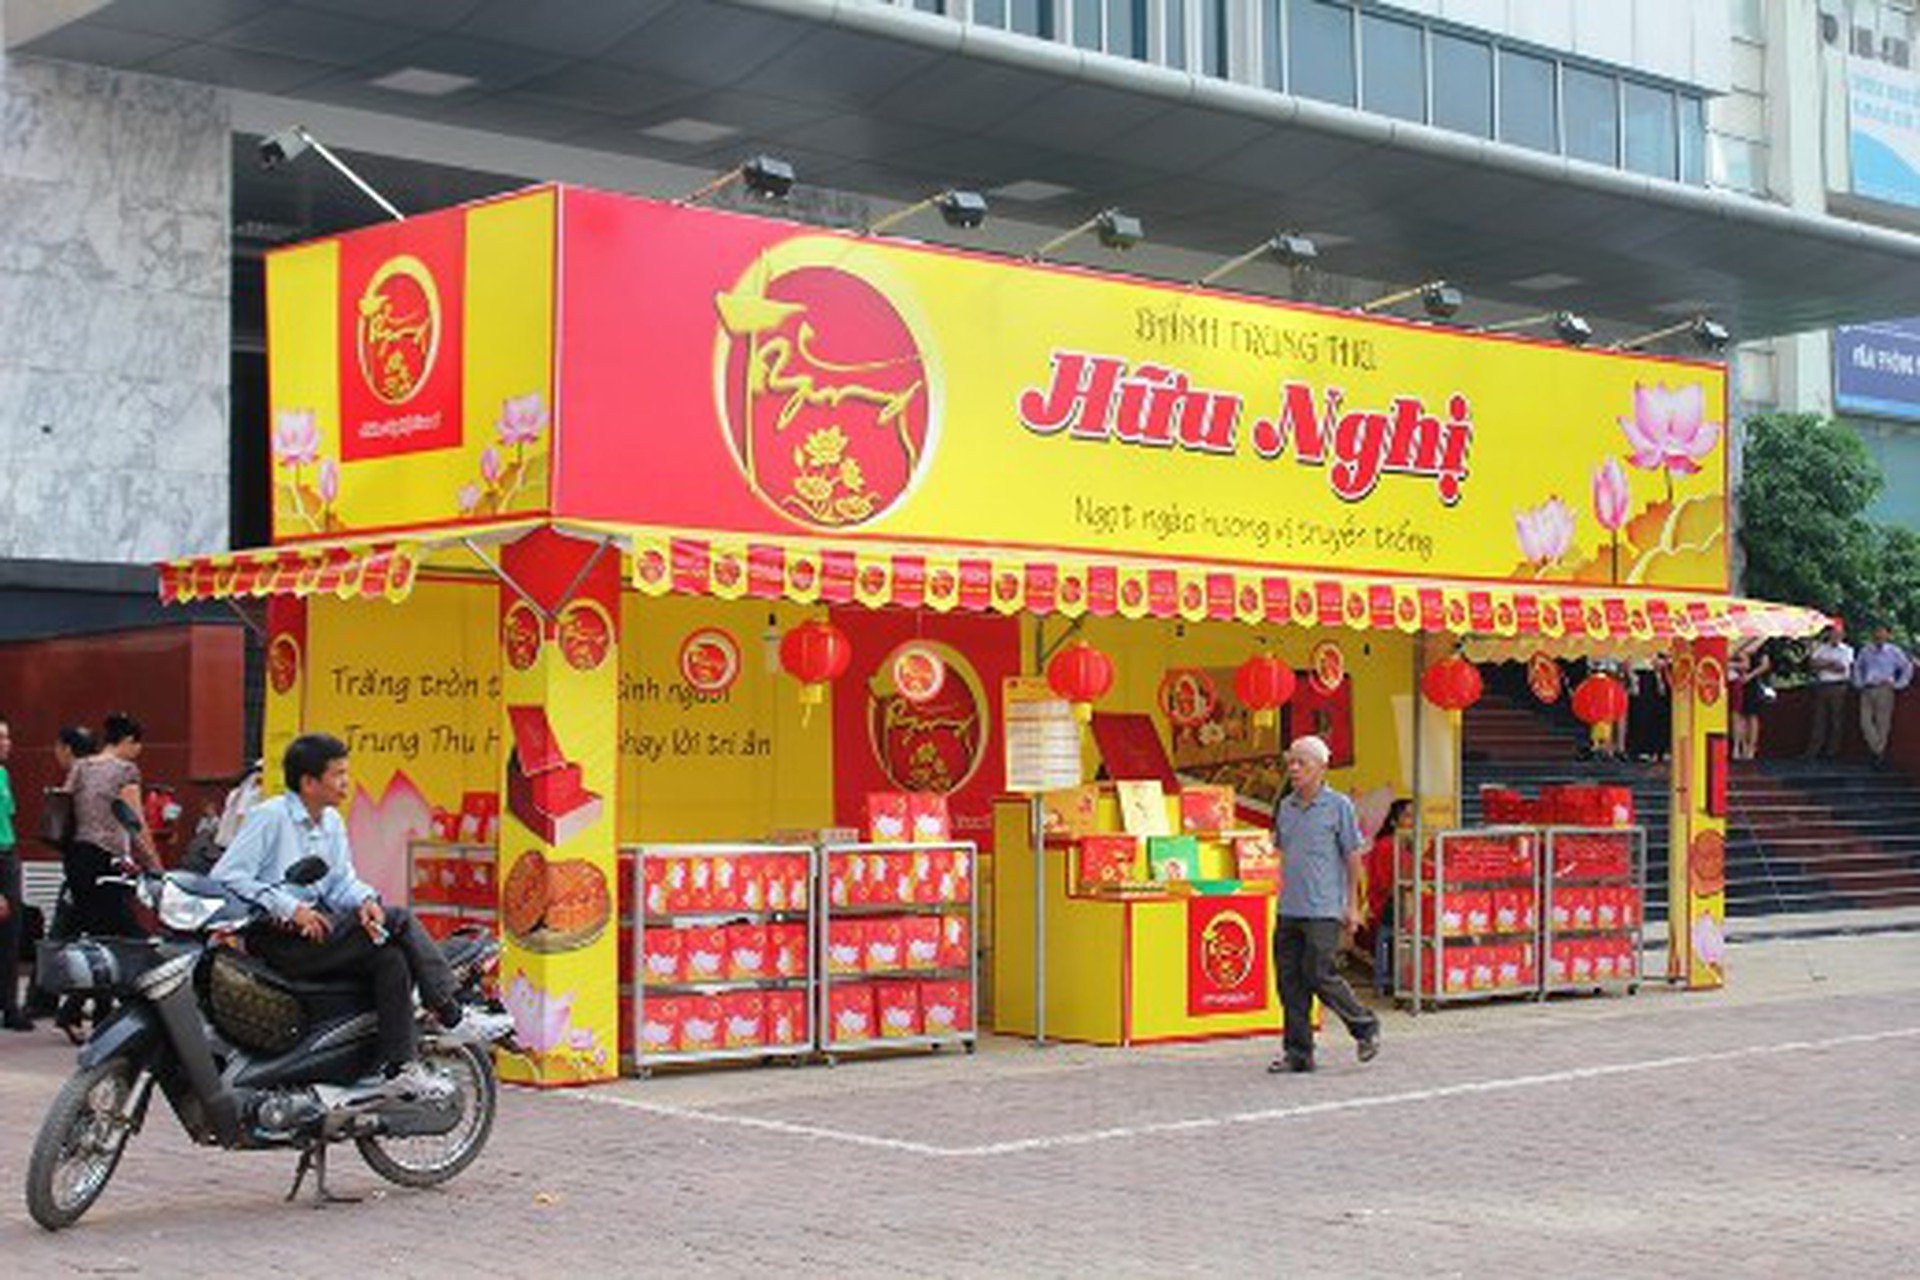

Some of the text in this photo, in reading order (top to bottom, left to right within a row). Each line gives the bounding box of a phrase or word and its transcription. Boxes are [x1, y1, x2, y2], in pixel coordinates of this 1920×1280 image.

[1019, 351, 1473, 505] Hữu Nghị
[331, 665, 410, 703] Trăng
[345, 724, 419, 762] Trung
[431, 725, 475, 754] Thu
